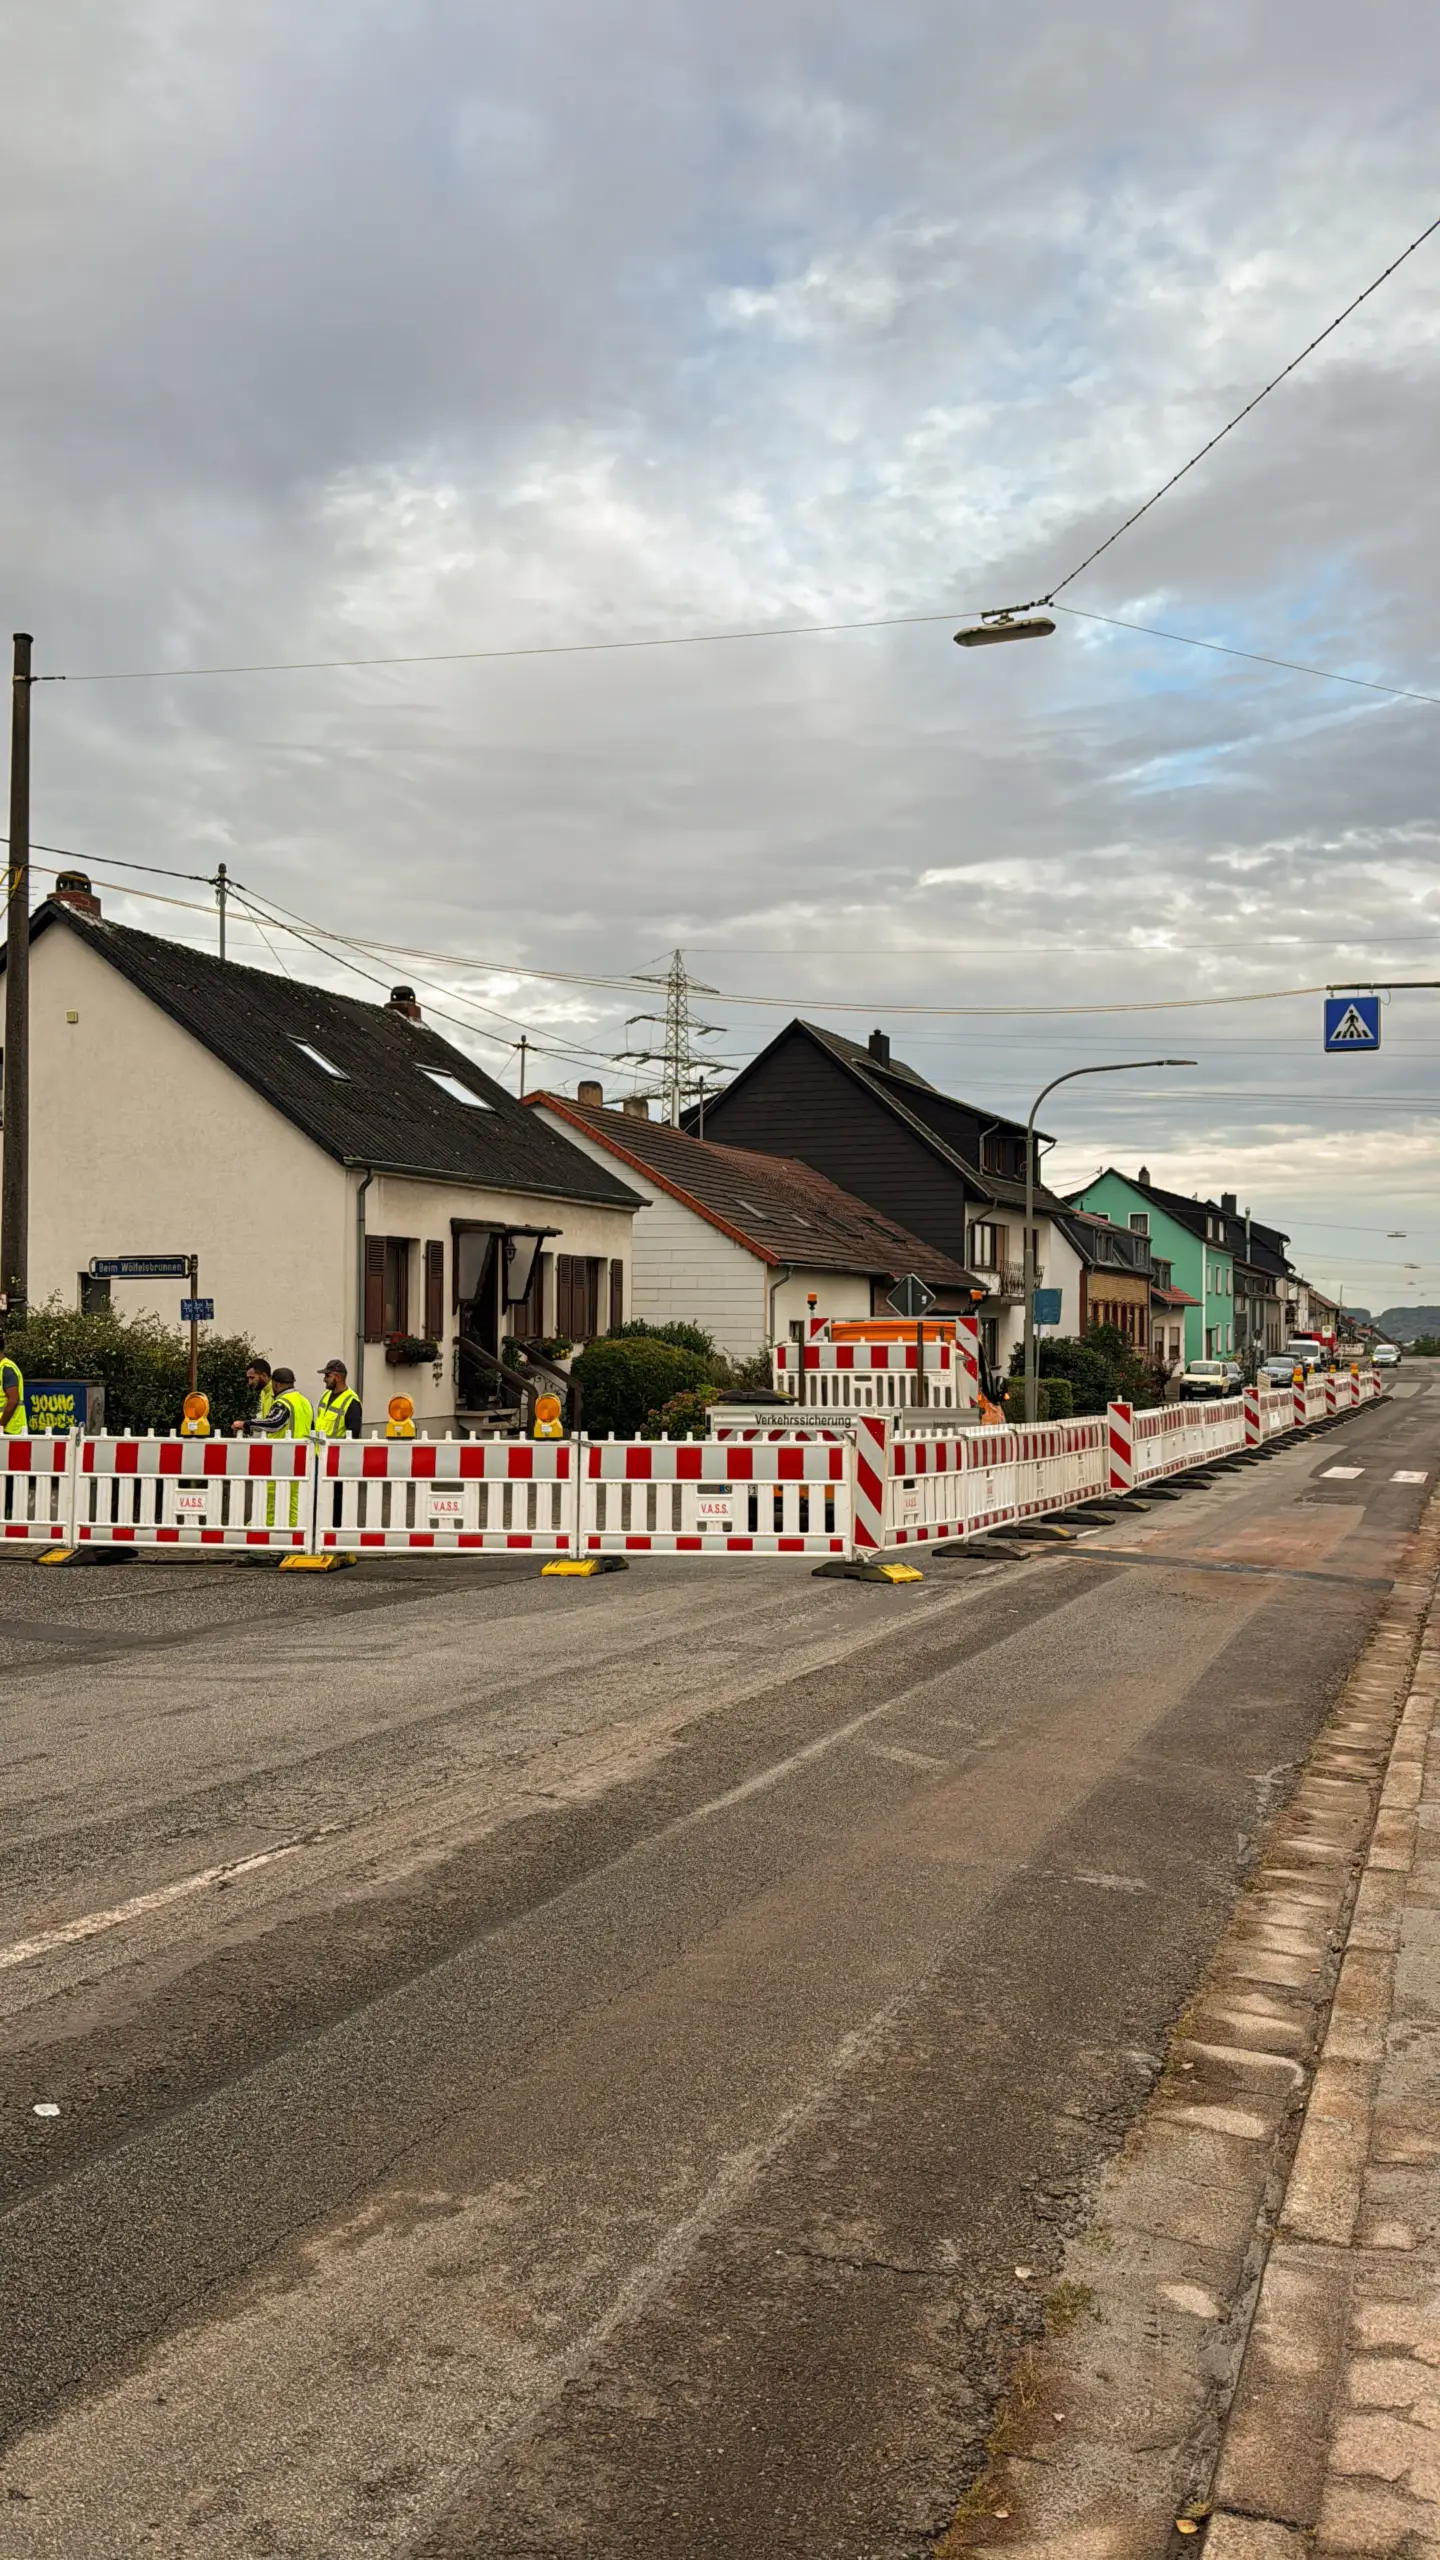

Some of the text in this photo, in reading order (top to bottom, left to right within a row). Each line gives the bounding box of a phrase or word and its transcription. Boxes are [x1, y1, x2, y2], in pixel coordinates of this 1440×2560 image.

[99, 1261, 182, 1273] Beim Wölfelsbrunnen
[31, 1394, 75, 1413] YOUNG
[755, 1413, 852, 1429] Verkehrssicherung
[180, 1497, 204, 1508] V.A.S.S.
[433, 1501, 460, 1511] V.A.S.S.
[701, 1503, 728, 1514] V.A.S.S.
